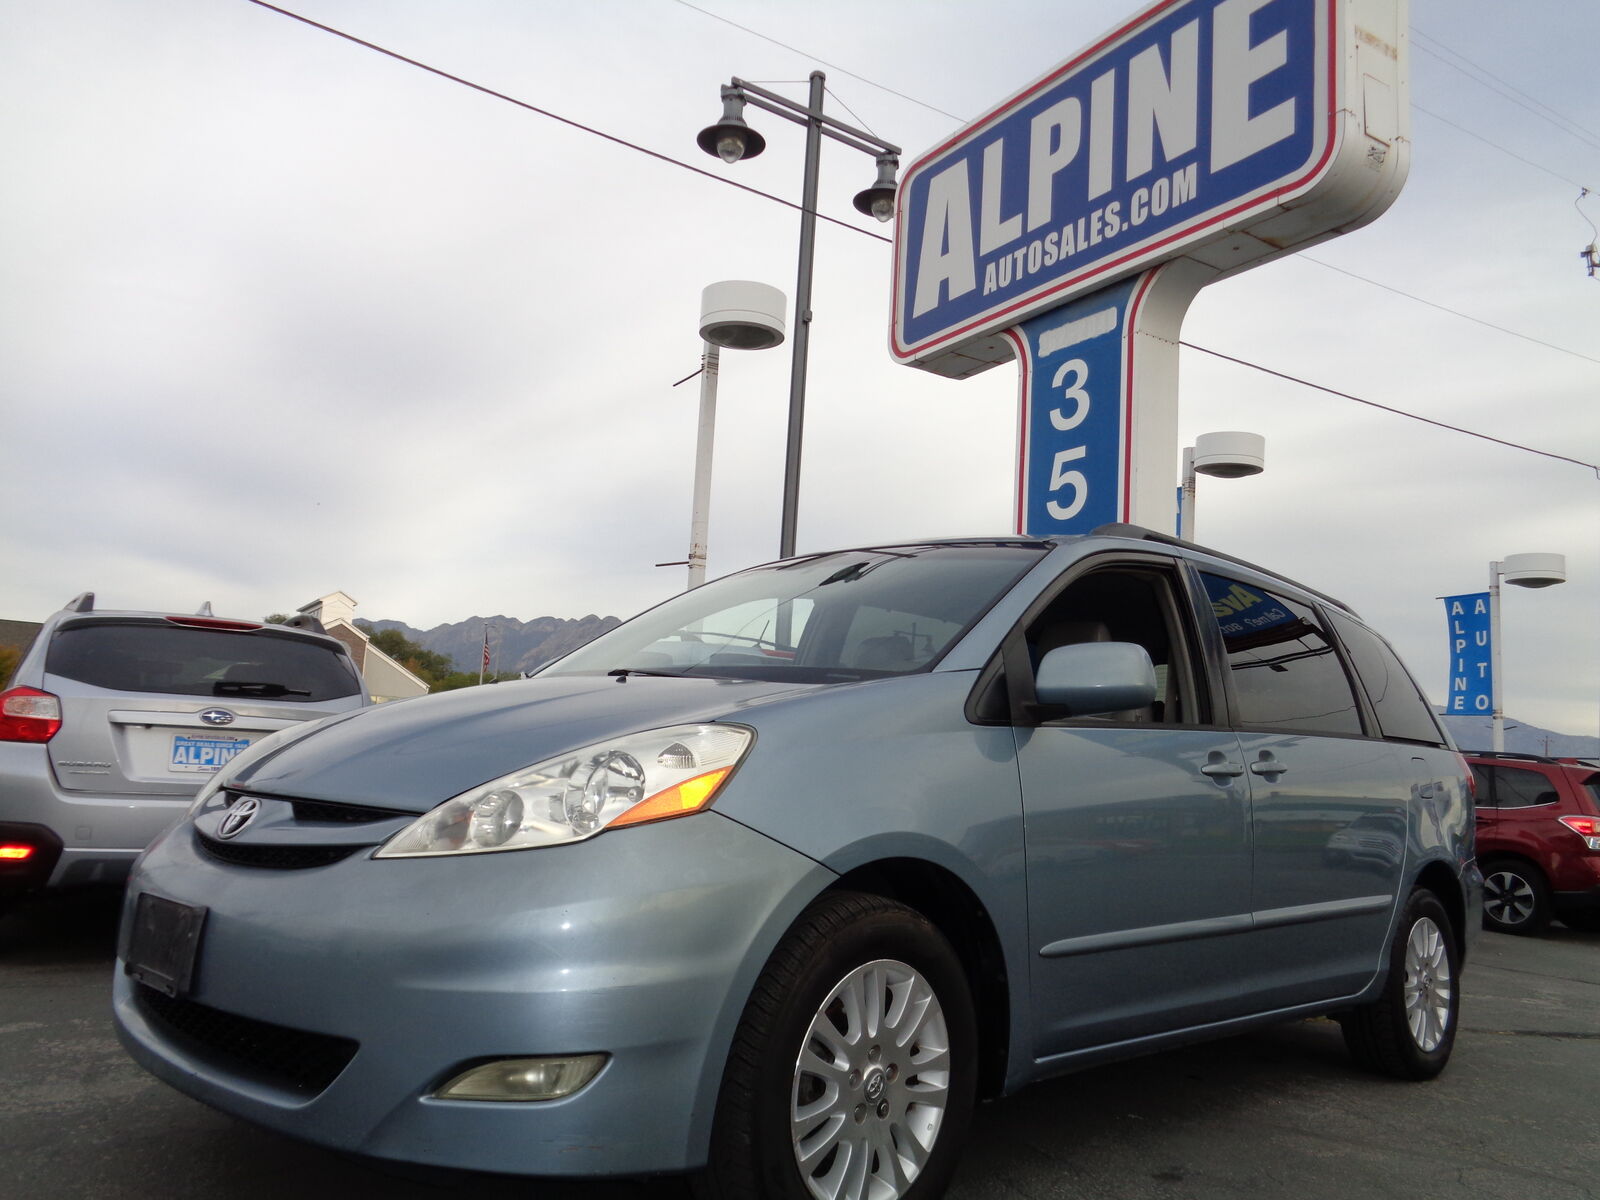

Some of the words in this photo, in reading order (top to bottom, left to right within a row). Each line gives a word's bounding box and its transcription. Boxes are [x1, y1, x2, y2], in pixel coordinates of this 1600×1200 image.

[911, 0, 1297, 319] ALPINE
[982, 161, 1198, 297] AUTOSALES.COM
[1451, 601, 1467, 710] ALPINE
[1474, 599, 1489, 710] AUTO
[173, 746, 245, 765] ALPIN
